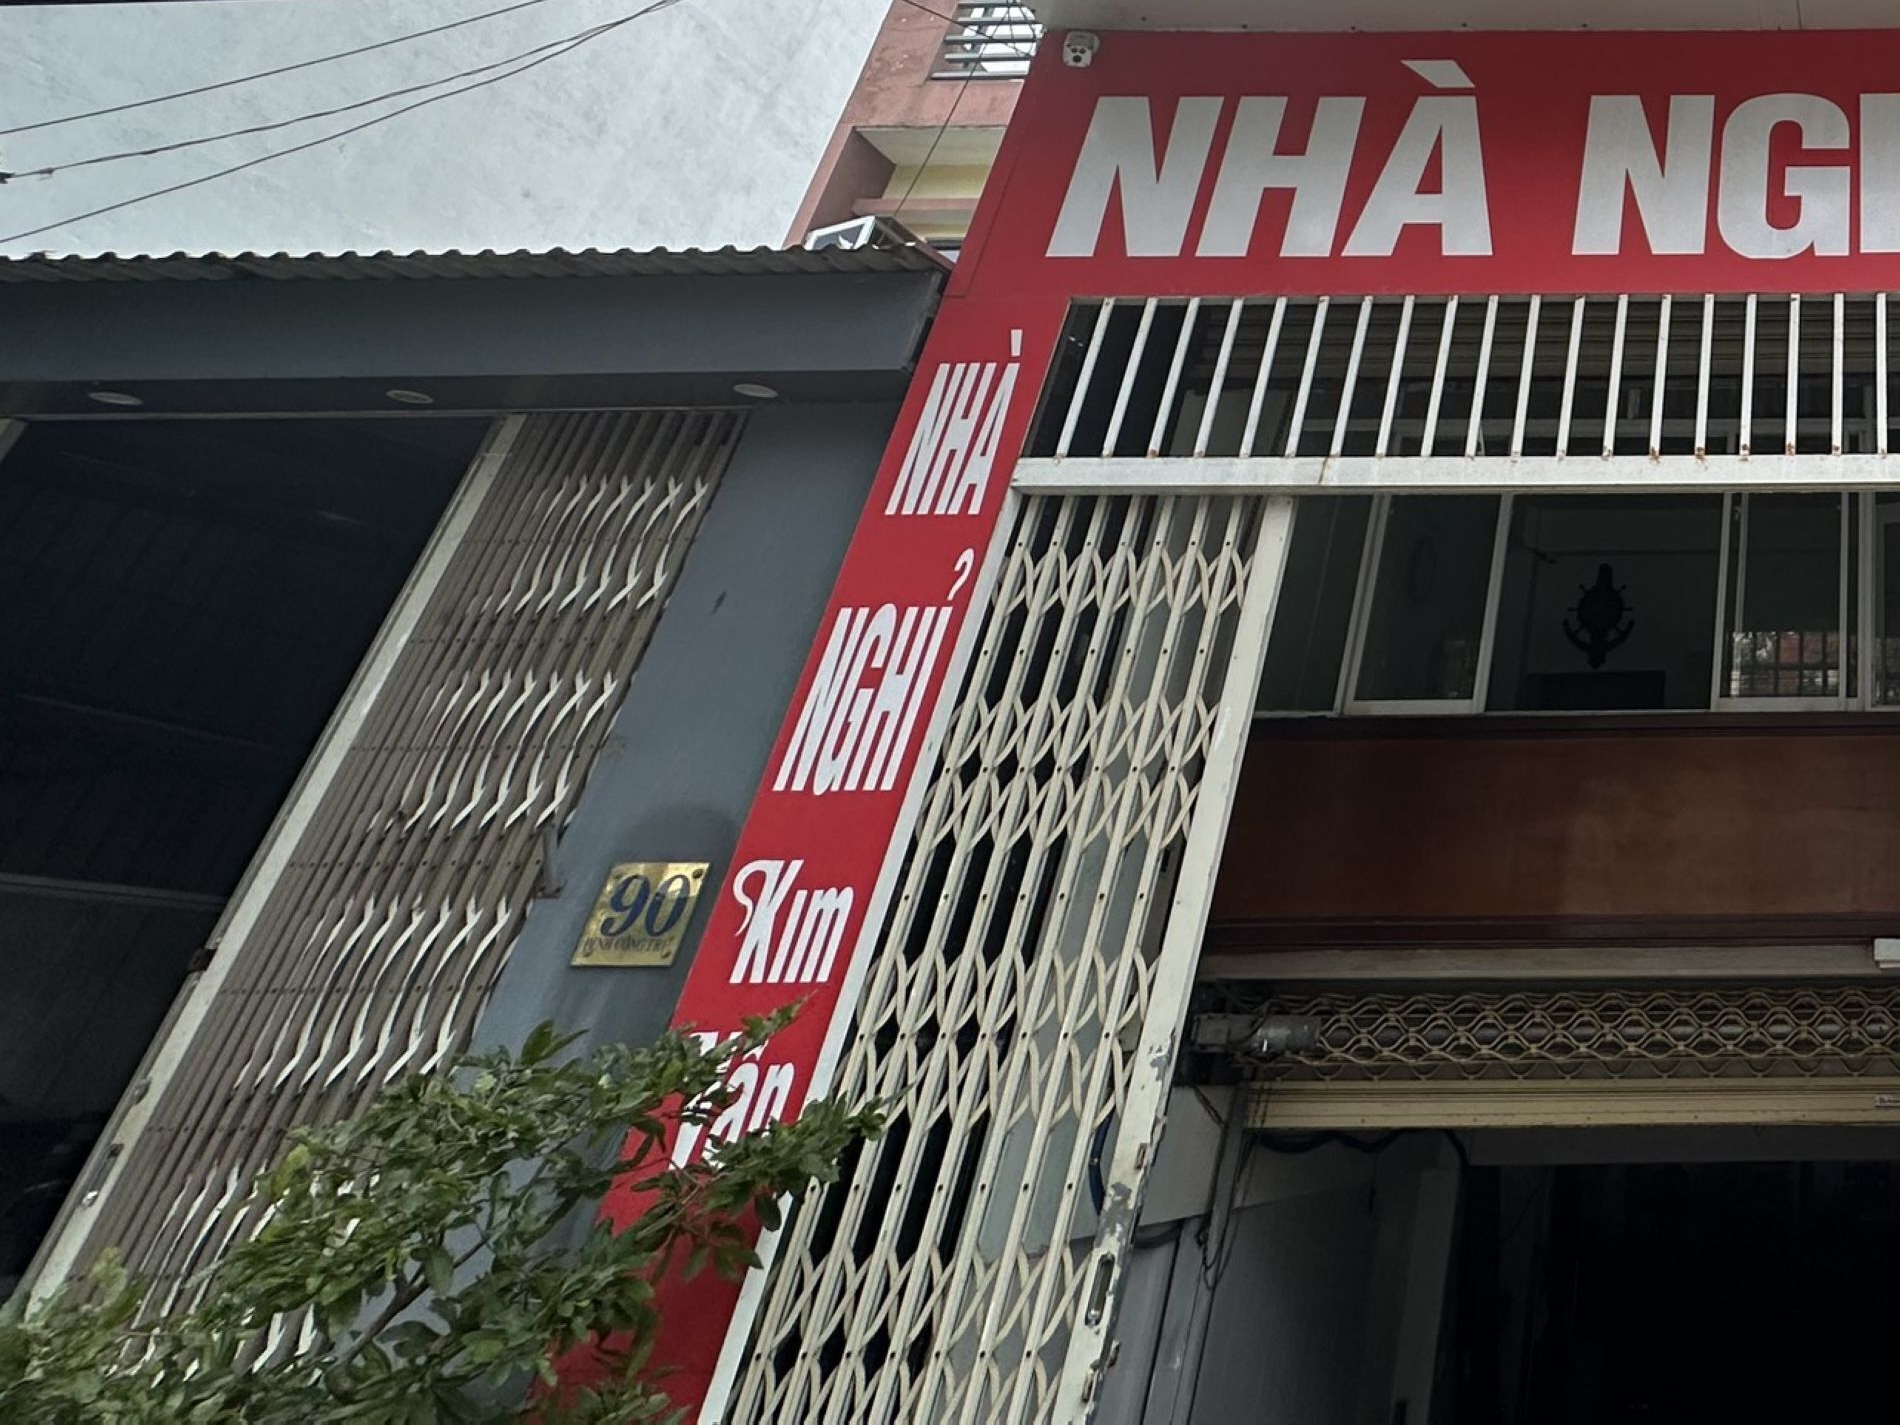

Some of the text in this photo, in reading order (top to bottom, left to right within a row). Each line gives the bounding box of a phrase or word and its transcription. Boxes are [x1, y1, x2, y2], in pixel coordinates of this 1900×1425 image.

[1046, 59, 1494, 258] NHÀ
[884, 328, 1024, 516] NHÀ
[772, 547, 975, 796] NGHỈ
[600, 874, 691, 937] 90
[730, 859, 855, 984] Kim
